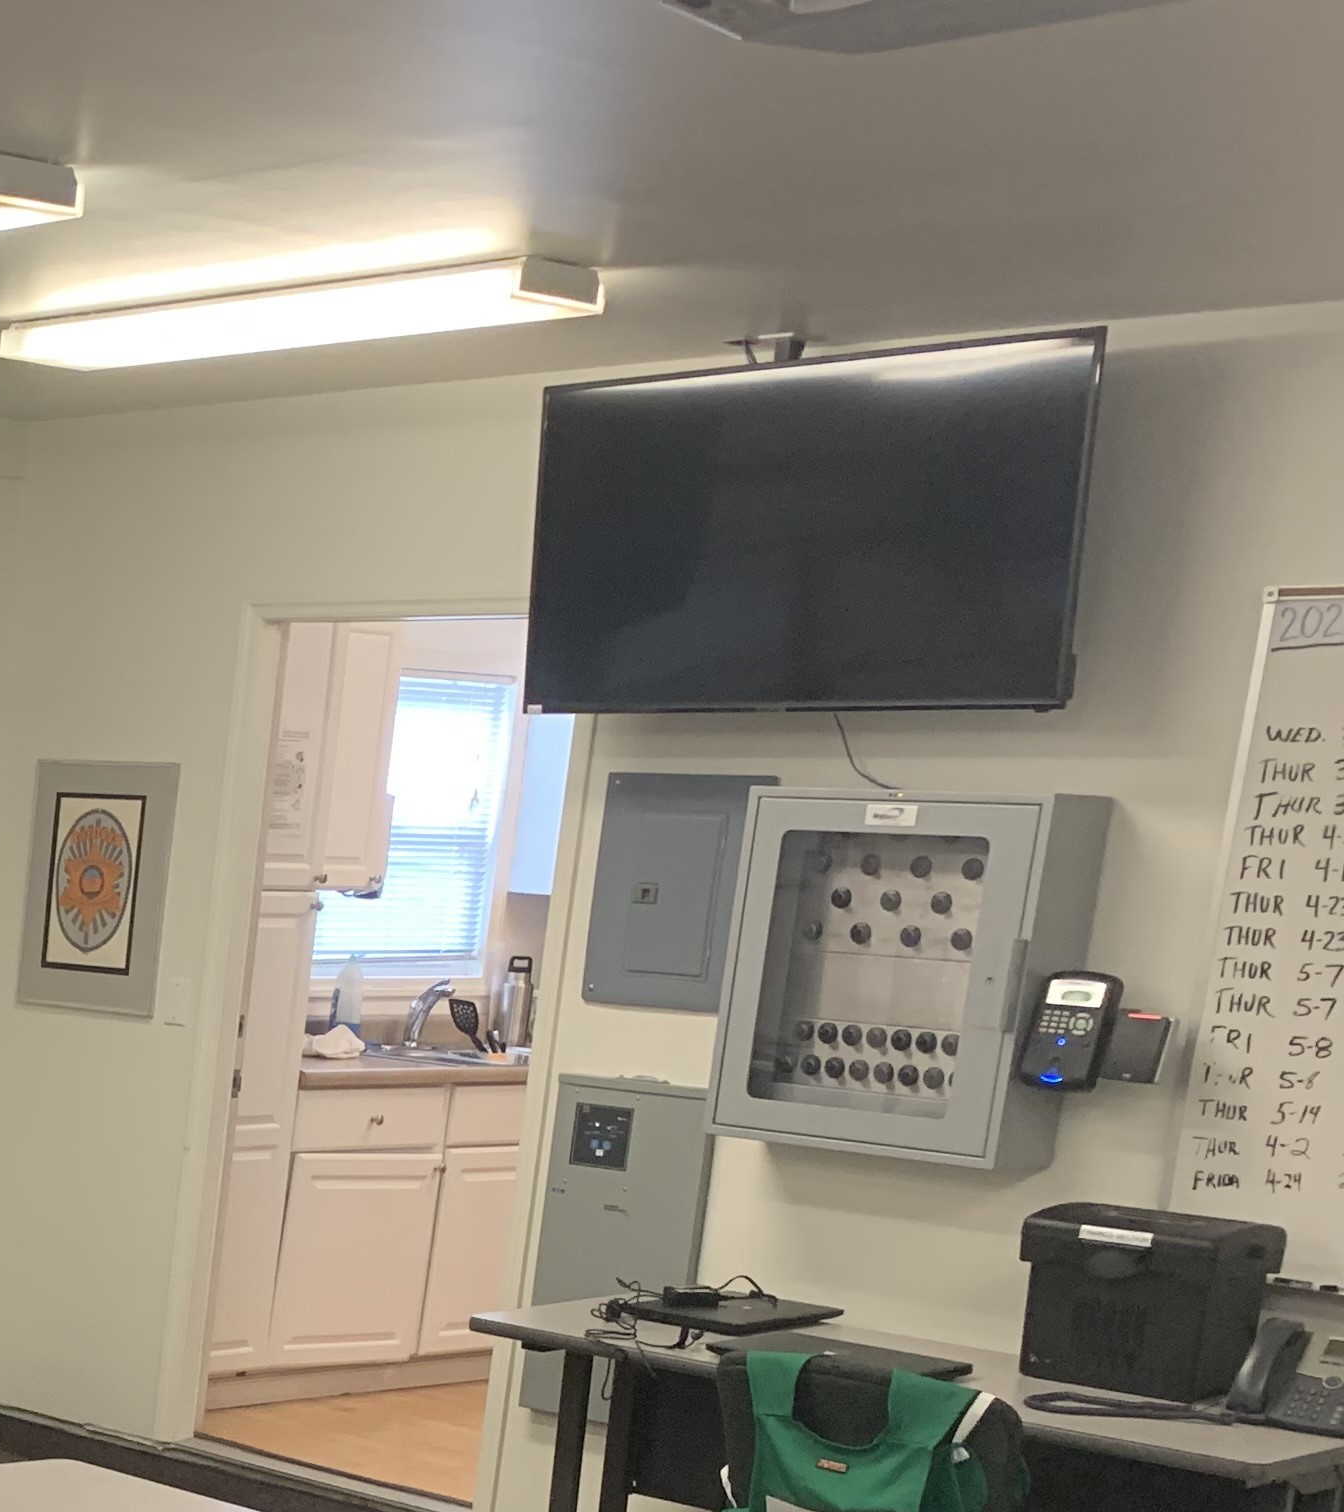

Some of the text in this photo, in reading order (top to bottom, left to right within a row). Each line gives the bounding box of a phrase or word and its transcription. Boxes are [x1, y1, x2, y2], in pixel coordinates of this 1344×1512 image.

[1260, 758, 1315, 783] THUR
[1253, 791, 1322, 821] THUR
[1244, 824, 1305, 848] THUR
[1240, 855, 1285, 880] FRI
[1230, 891, 1284, 916] THUR
[1223, 925, 1277, 949] THUR
[1217, 956, 1344, 988] THUR 5-7
[1215, 987, 1338, 1021] THUR 5-7
[1288, 1036, 1333, 1059] 5-8
[1198, 1099, 1322, 1125] THUR 5-14
[1192, 1134, 1311, 1160] THUR 4-2
